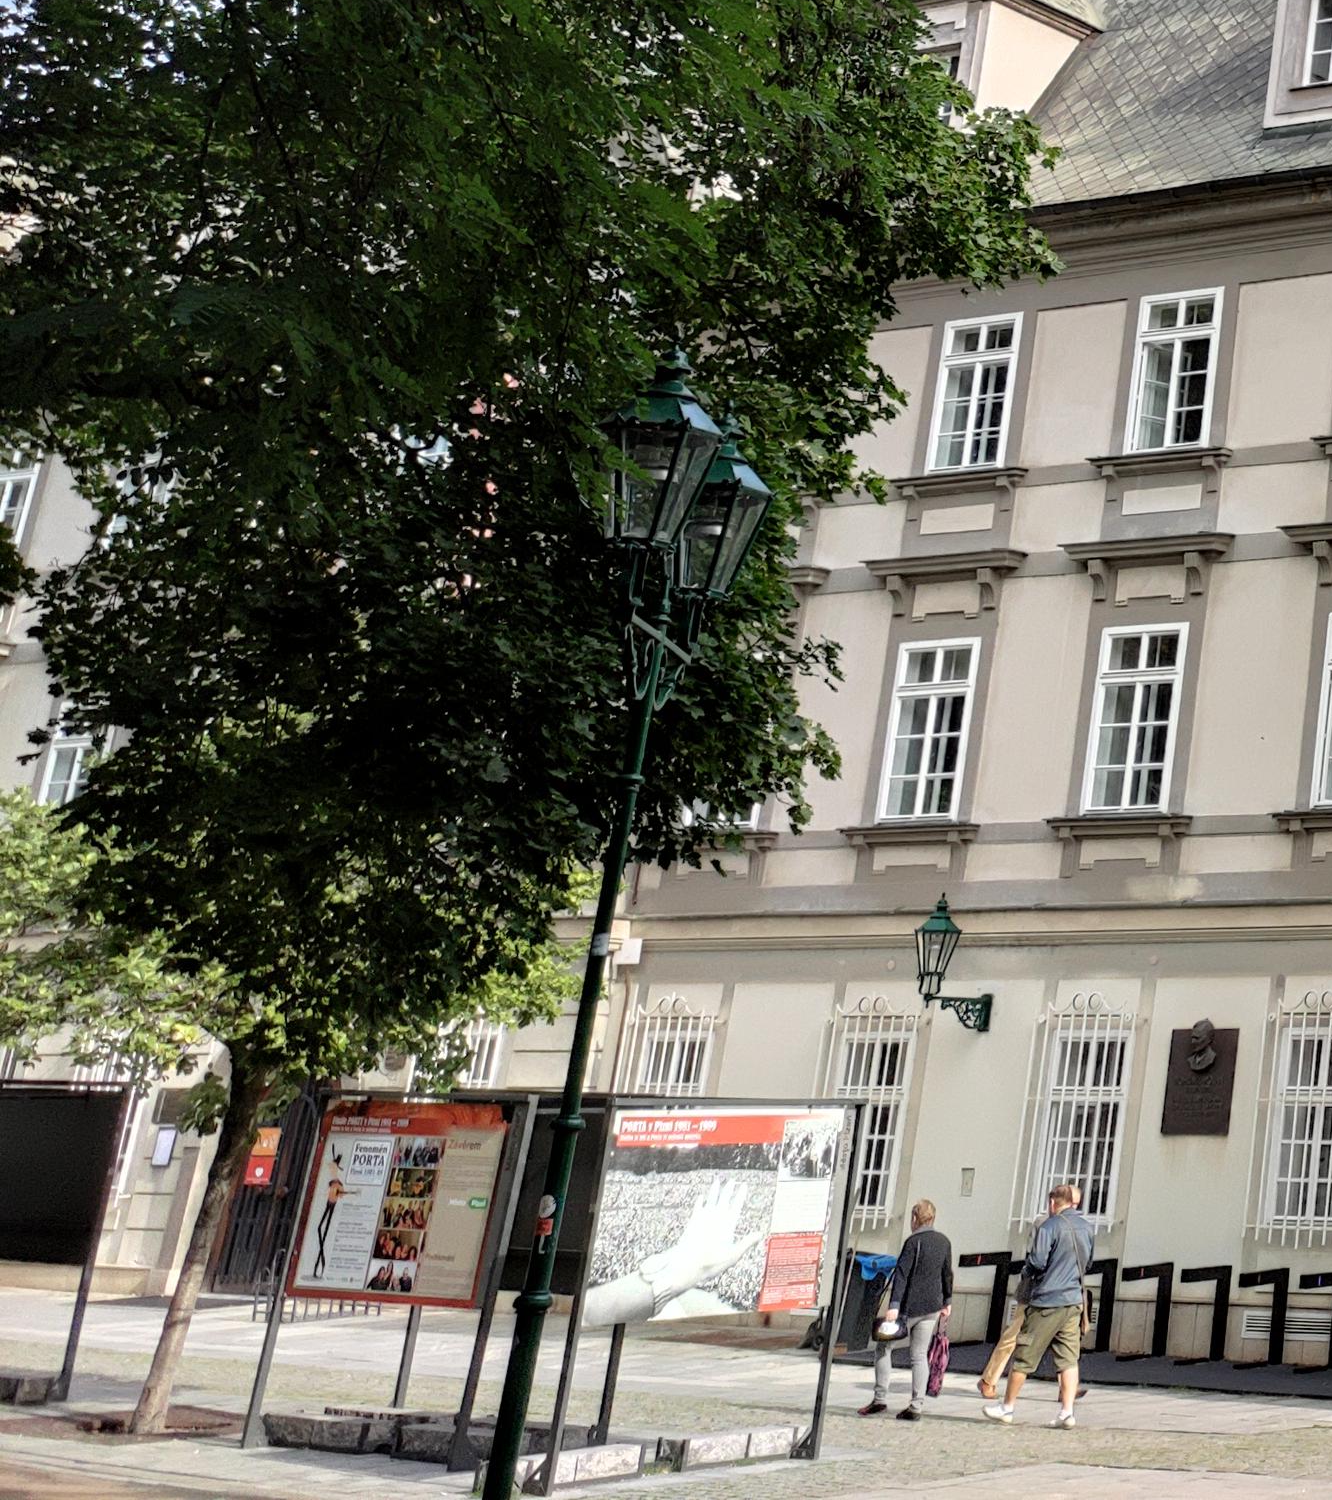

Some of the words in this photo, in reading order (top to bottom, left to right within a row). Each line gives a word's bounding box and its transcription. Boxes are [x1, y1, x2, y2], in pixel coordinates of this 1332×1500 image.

[622, 1120, 647, 1133] PORTA
[355, 1143, 388, 1154] Fenomén
[352, 1154, 385, 1167] PORTA
